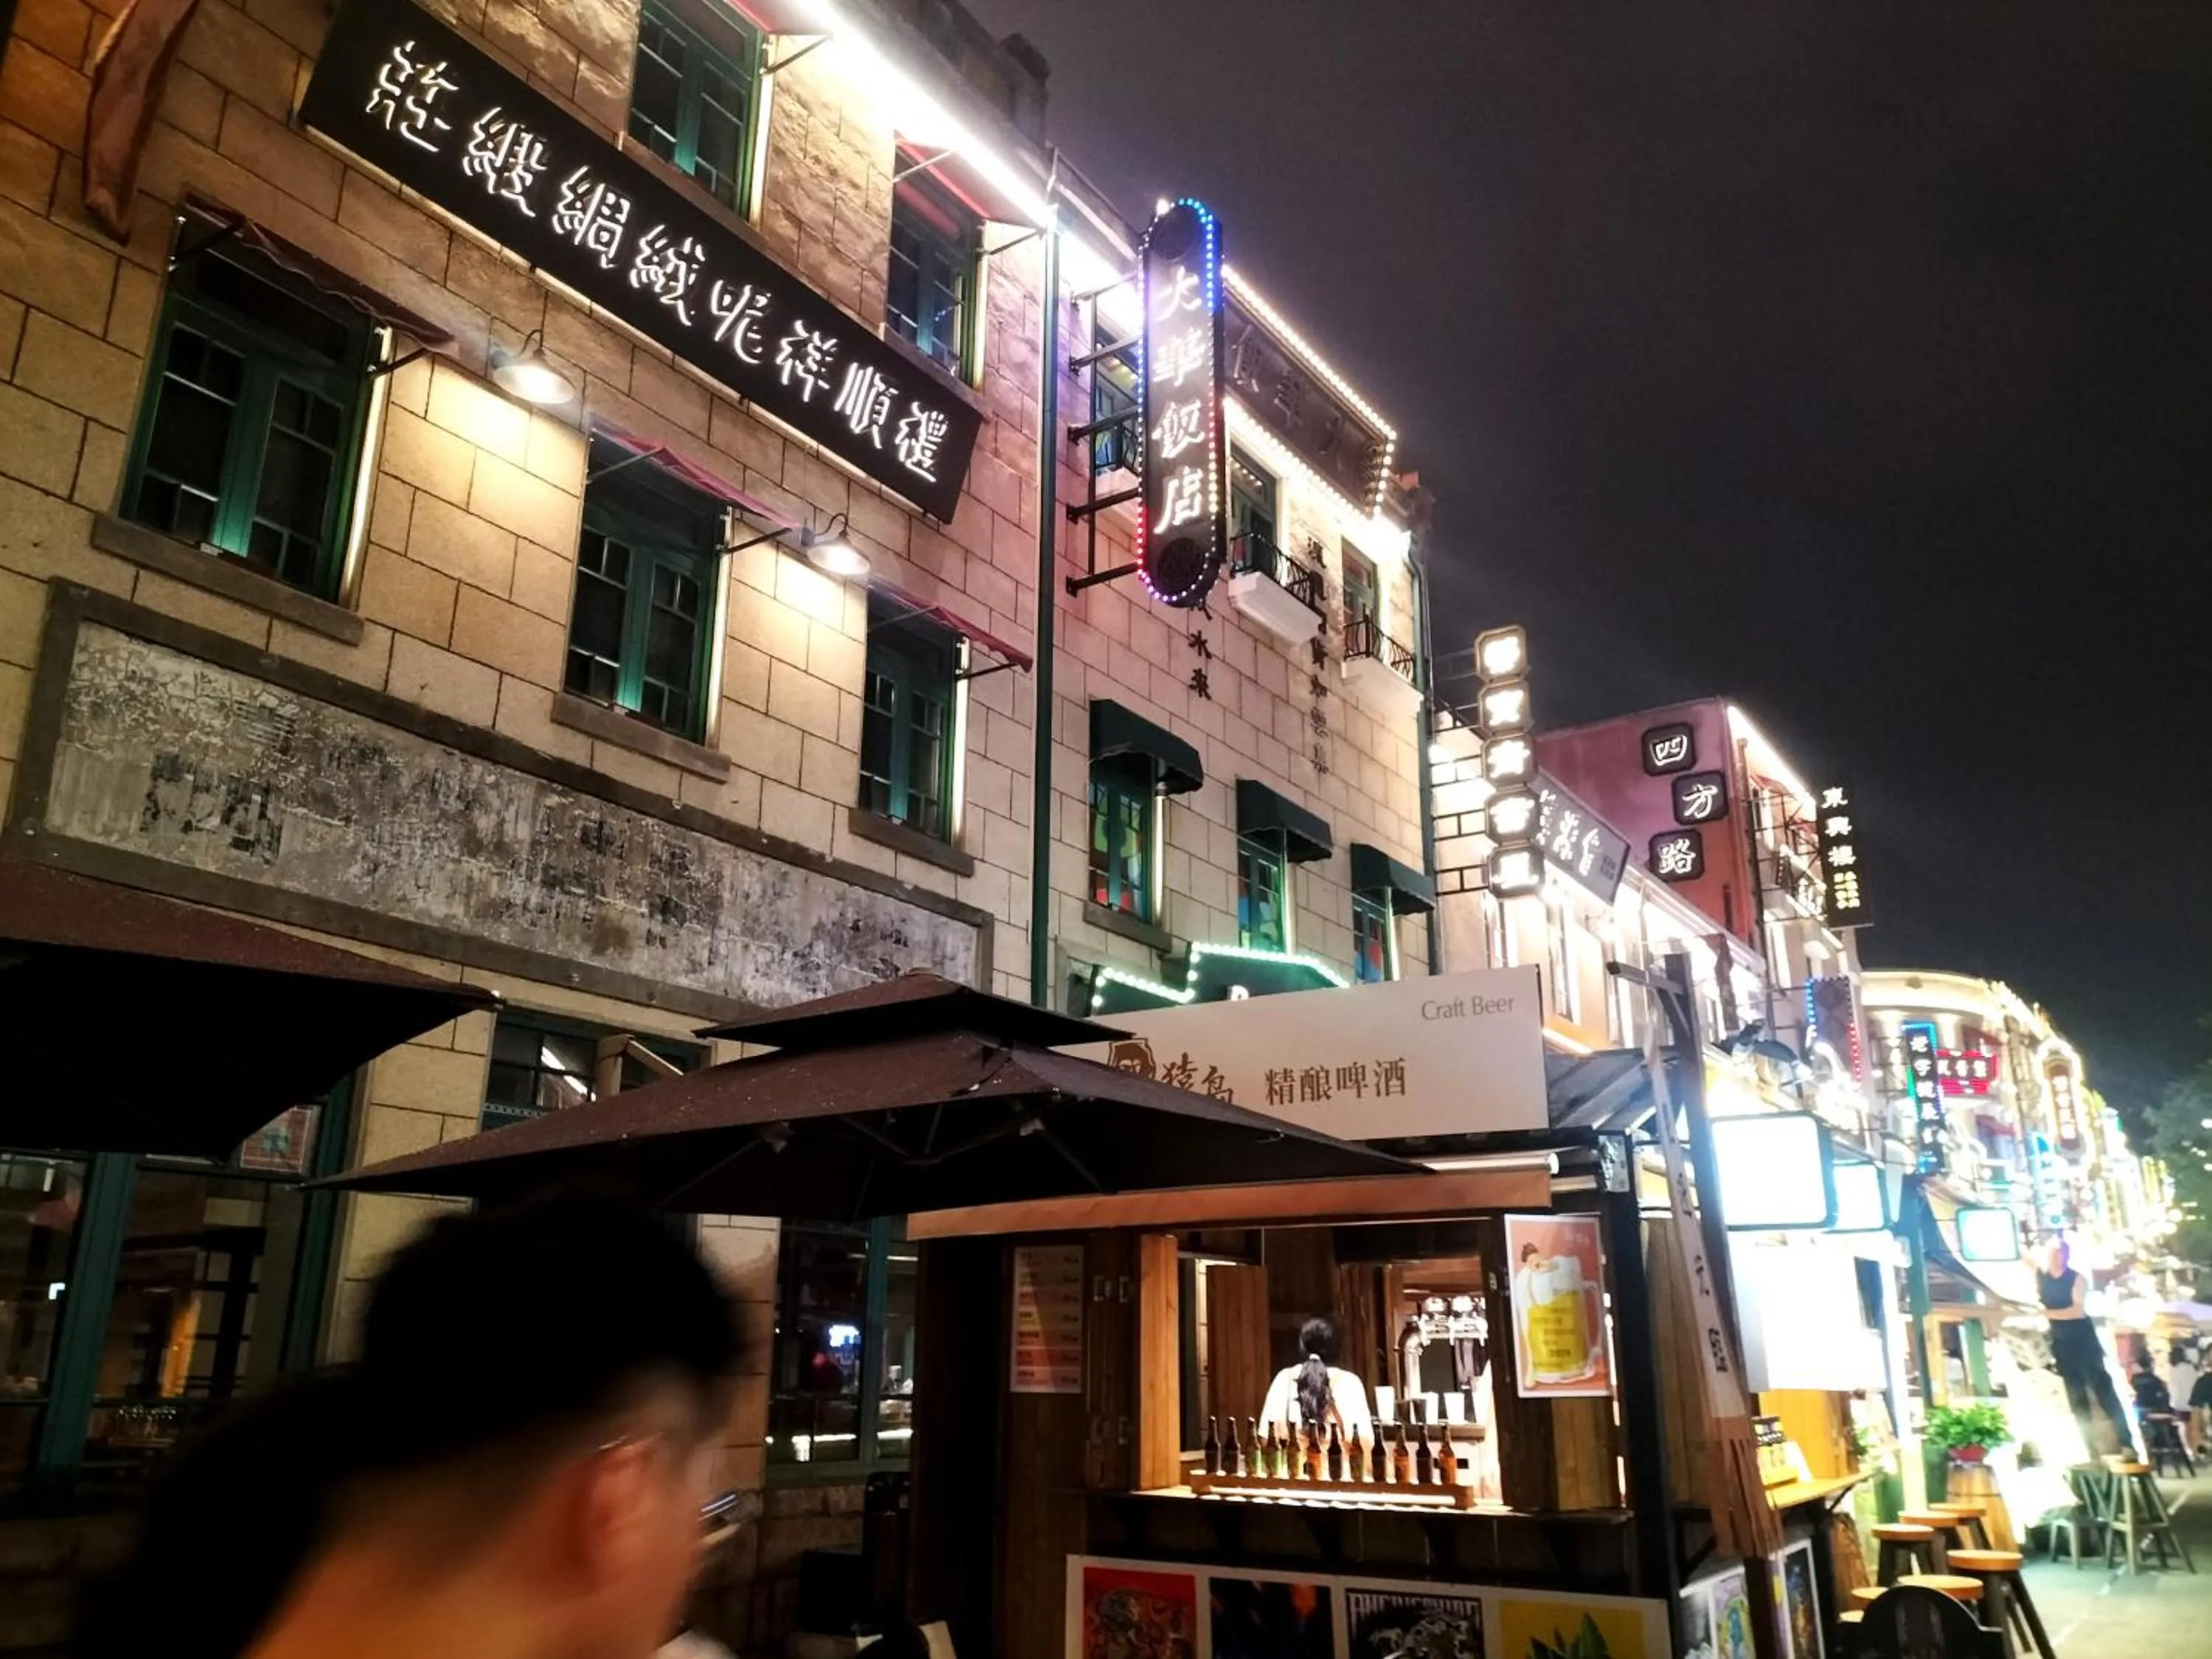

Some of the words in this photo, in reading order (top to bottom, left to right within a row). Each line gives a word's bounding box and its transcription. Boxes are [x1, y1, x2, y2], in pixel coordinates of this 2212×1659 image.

[1151, 265, 1206, 535] 大華飯店
[1650, 733, 1719, 875] 四方路
[1421, 995, 1469, 1020] Craft
[1472, 994, 1514, 1015] Beer
[1264, 1057, 1406, 1105] 精酿啤酒
